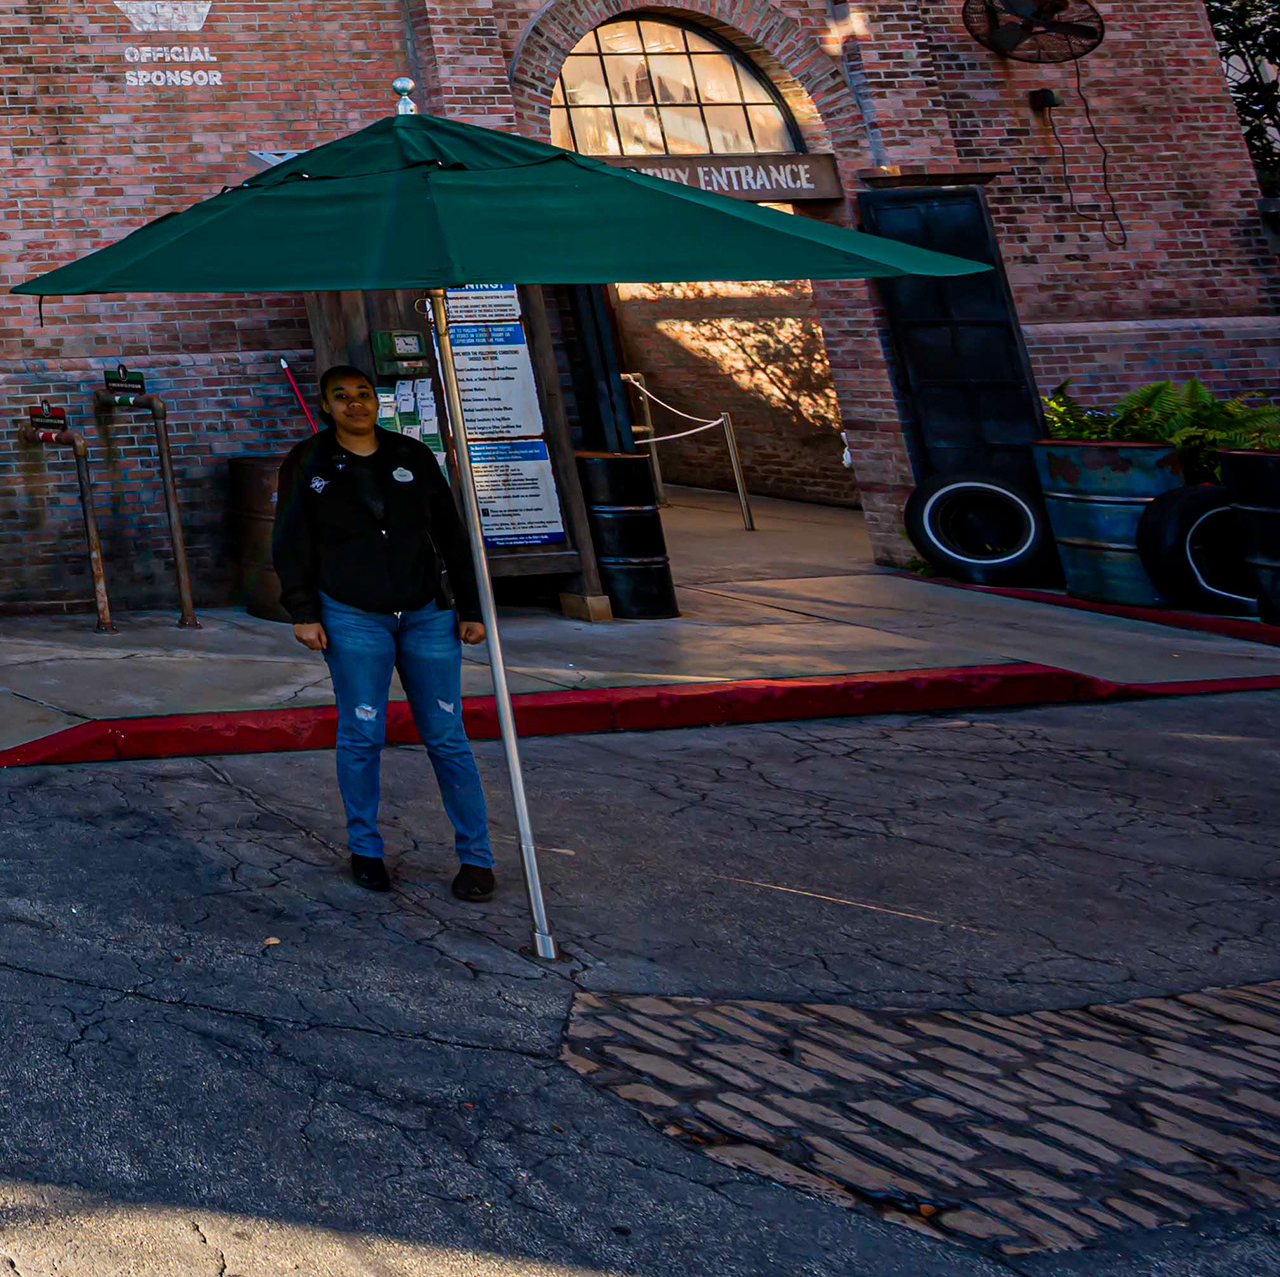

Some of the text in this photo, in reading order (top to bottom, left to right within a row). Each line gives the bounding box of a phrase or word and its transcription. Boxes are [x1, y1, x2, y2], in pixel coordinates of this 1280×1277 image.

[124, 46, 217, 63] OFFICIAL
[125, 70, 223, 86] SPONSOR
[697, 164, 815, 192] ENTRANCE
